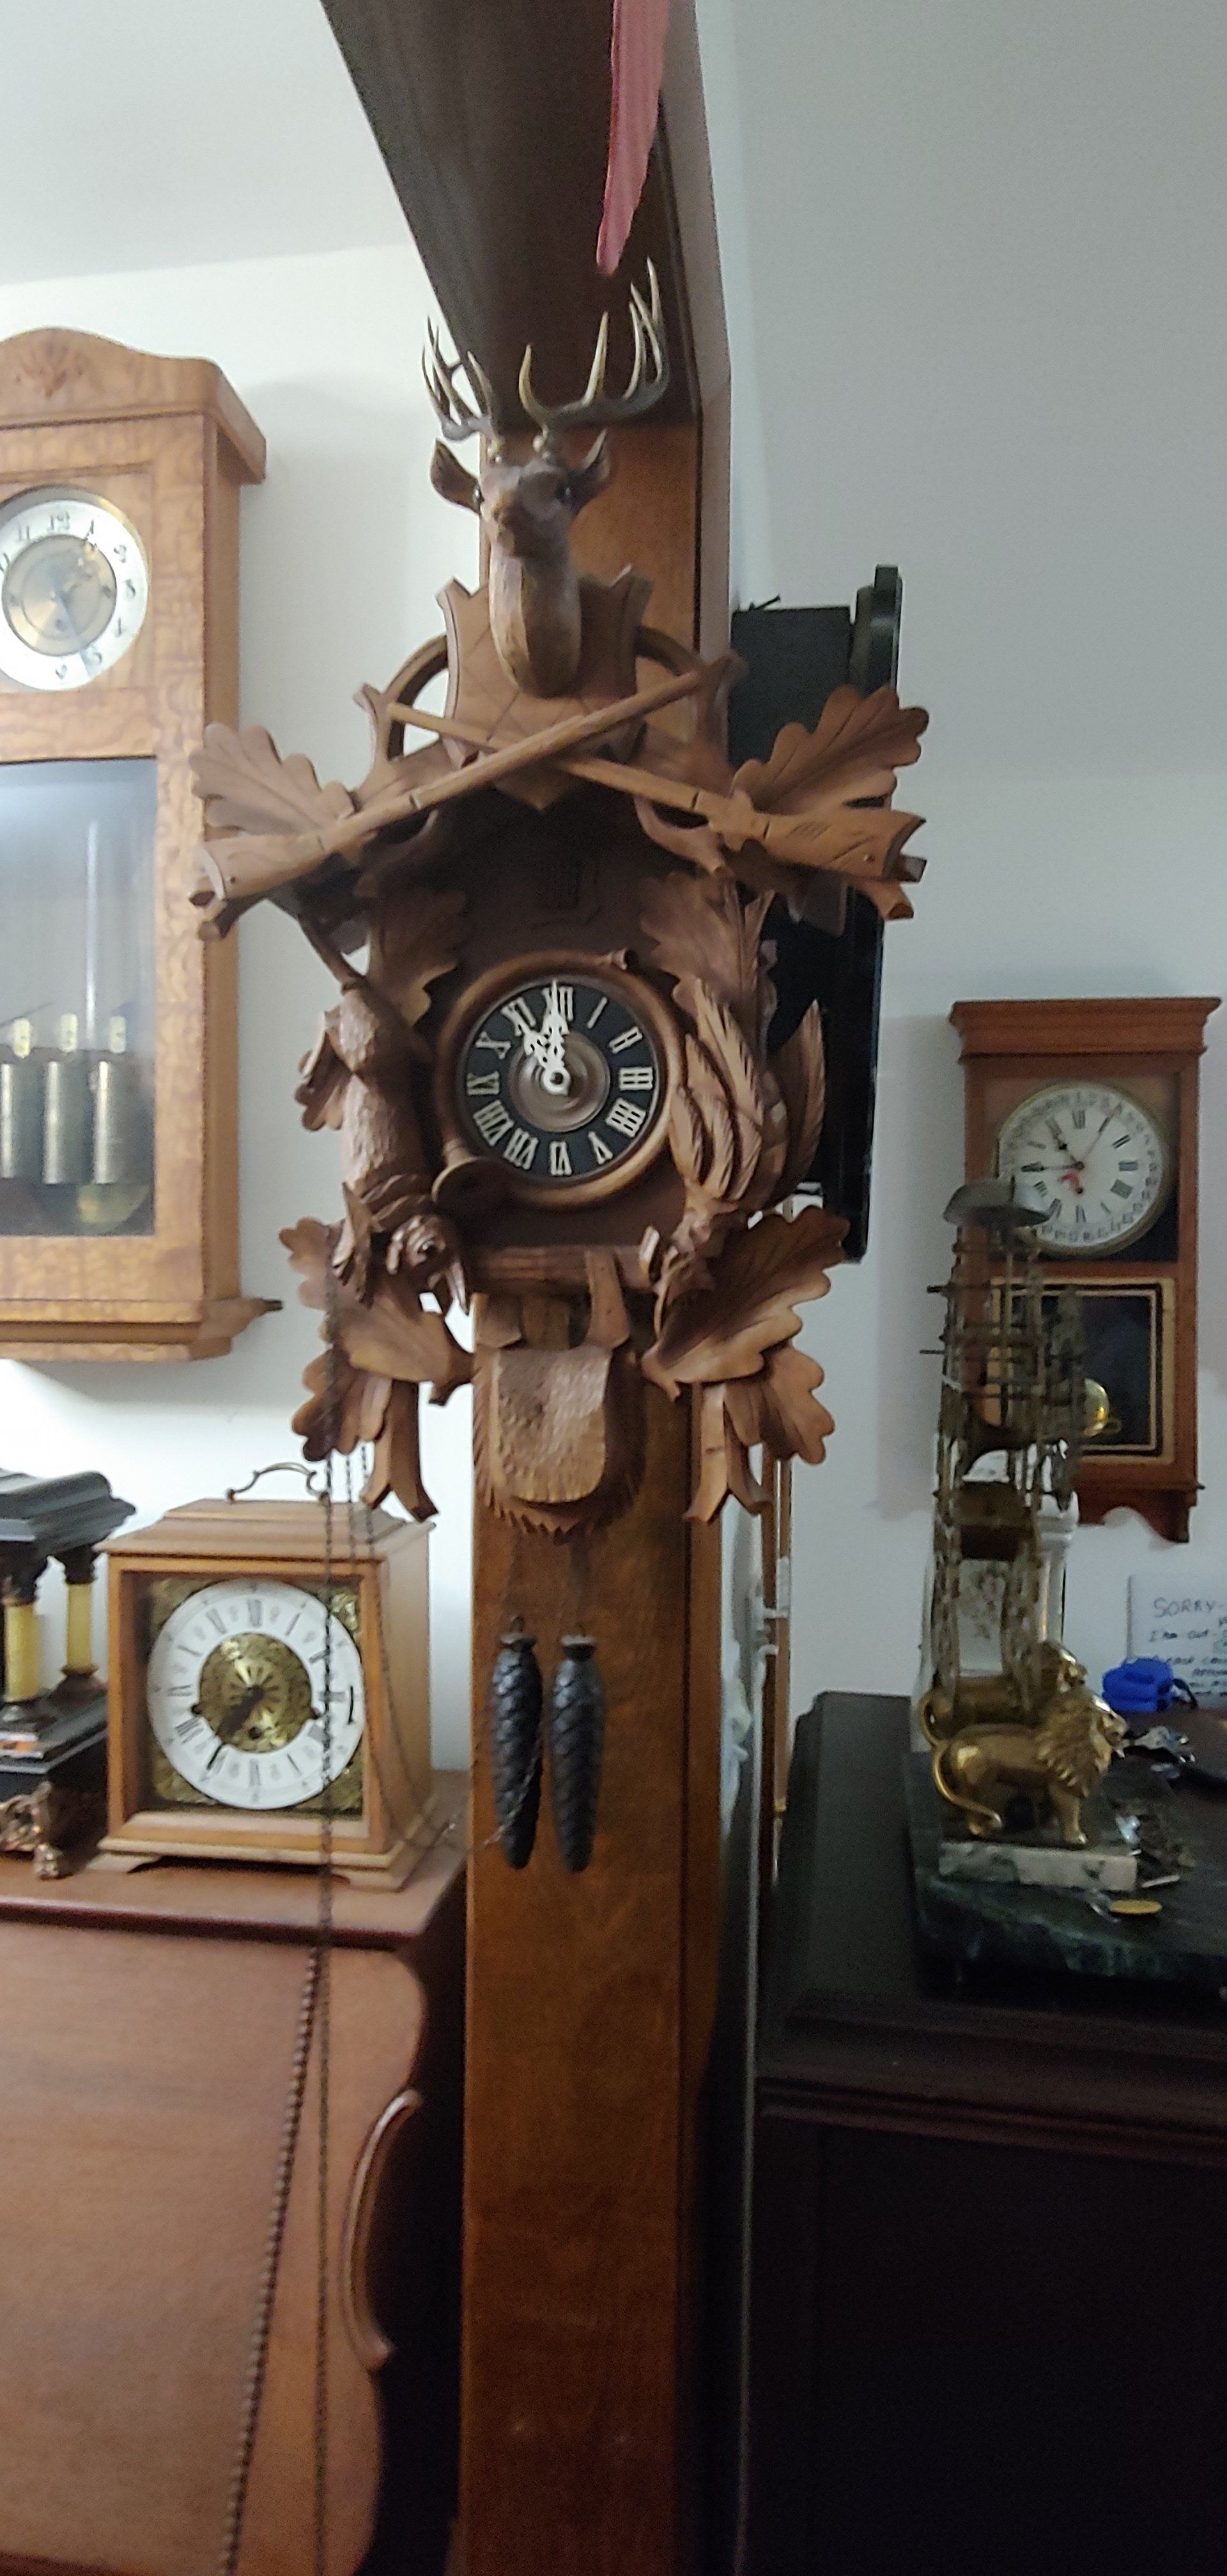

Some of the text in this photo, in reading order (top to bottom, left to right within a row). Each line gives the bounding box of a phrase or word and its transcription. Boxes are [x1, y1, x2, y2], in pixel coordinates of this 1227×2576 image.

[475, 1030, 511, 1060] X
[608, 1026, 643, 1055] II
[619, 1066, 653, 1091] III
[1154, 1597, 1215, 1618] SORRY
